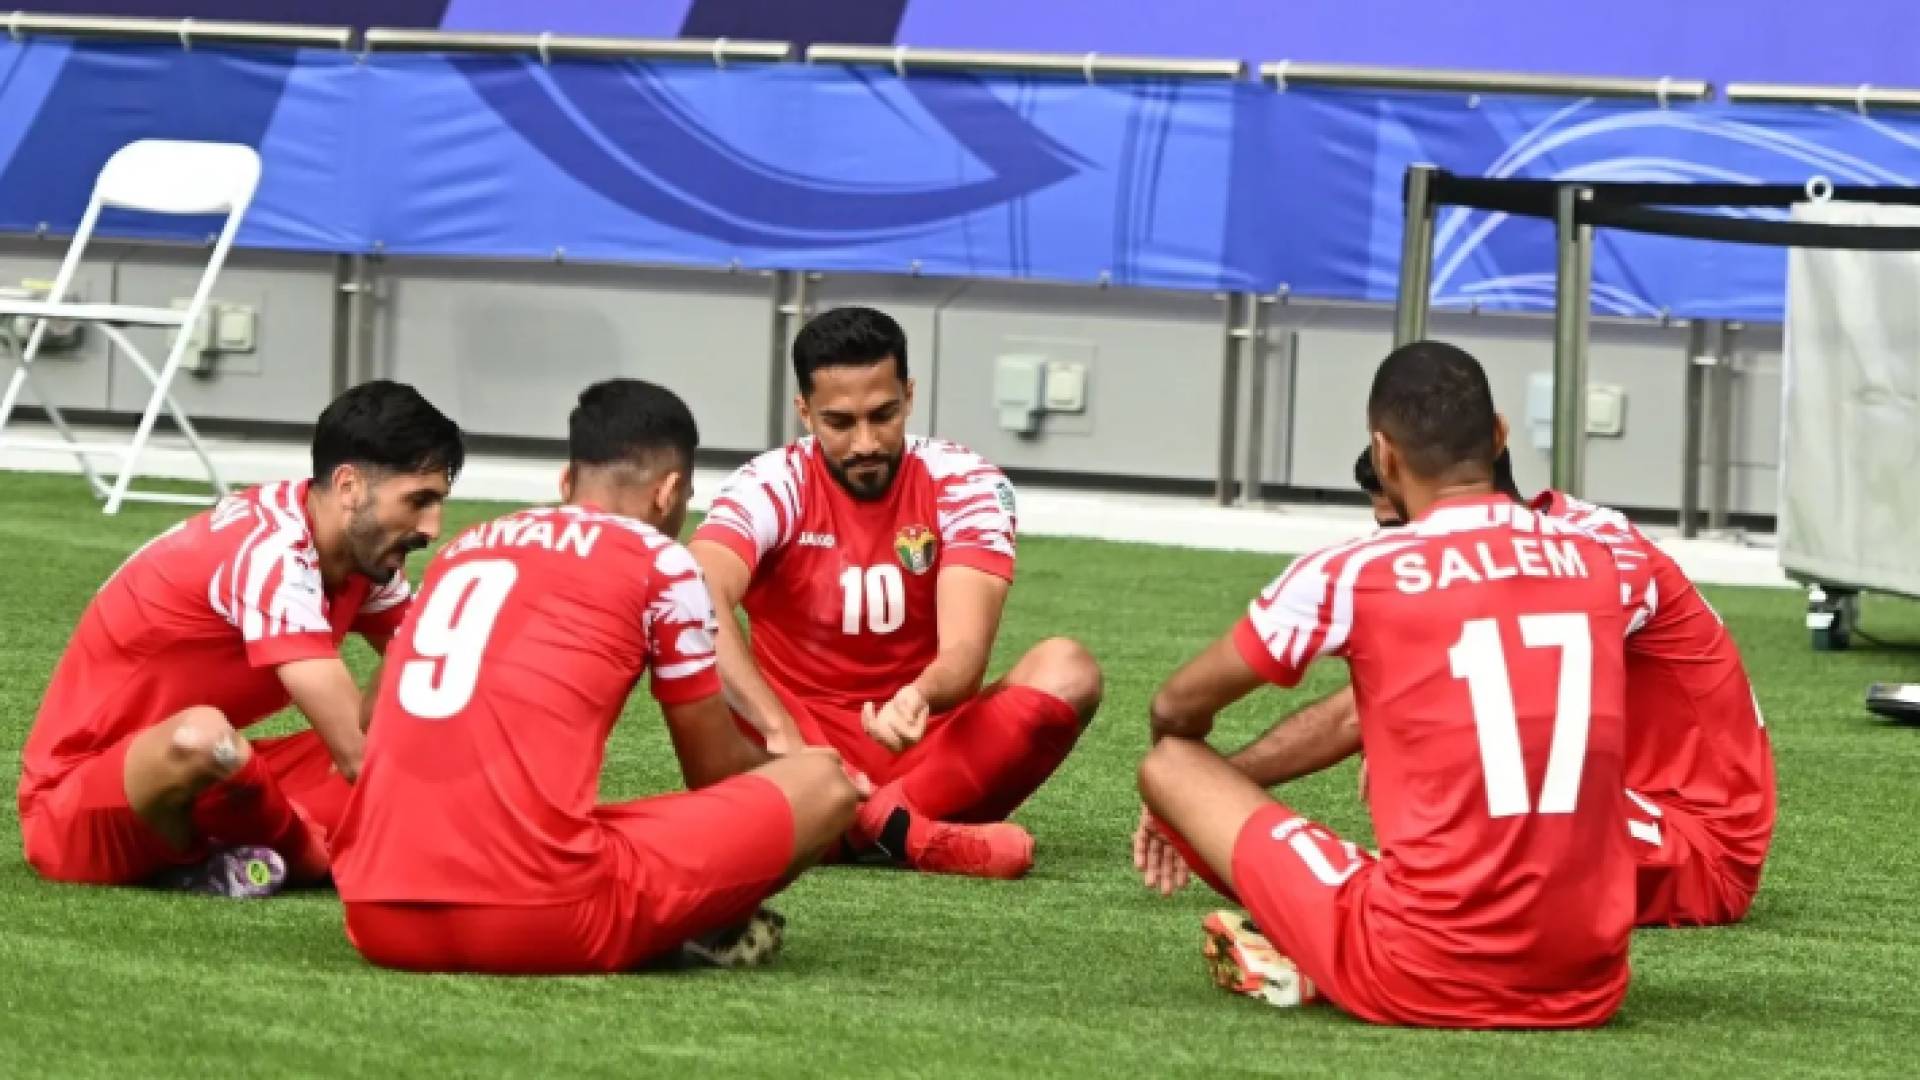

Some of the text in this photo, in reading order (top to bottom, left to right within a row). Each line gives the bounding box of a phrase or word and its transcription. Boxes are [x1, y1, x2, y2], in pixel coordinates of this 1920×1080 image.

[840, 564, 905, 634] 10
[1393, 538, 1587, 594] SALEM
[398, 558, 518, 719] 9
[1448, 612, 1592, 817] 17
